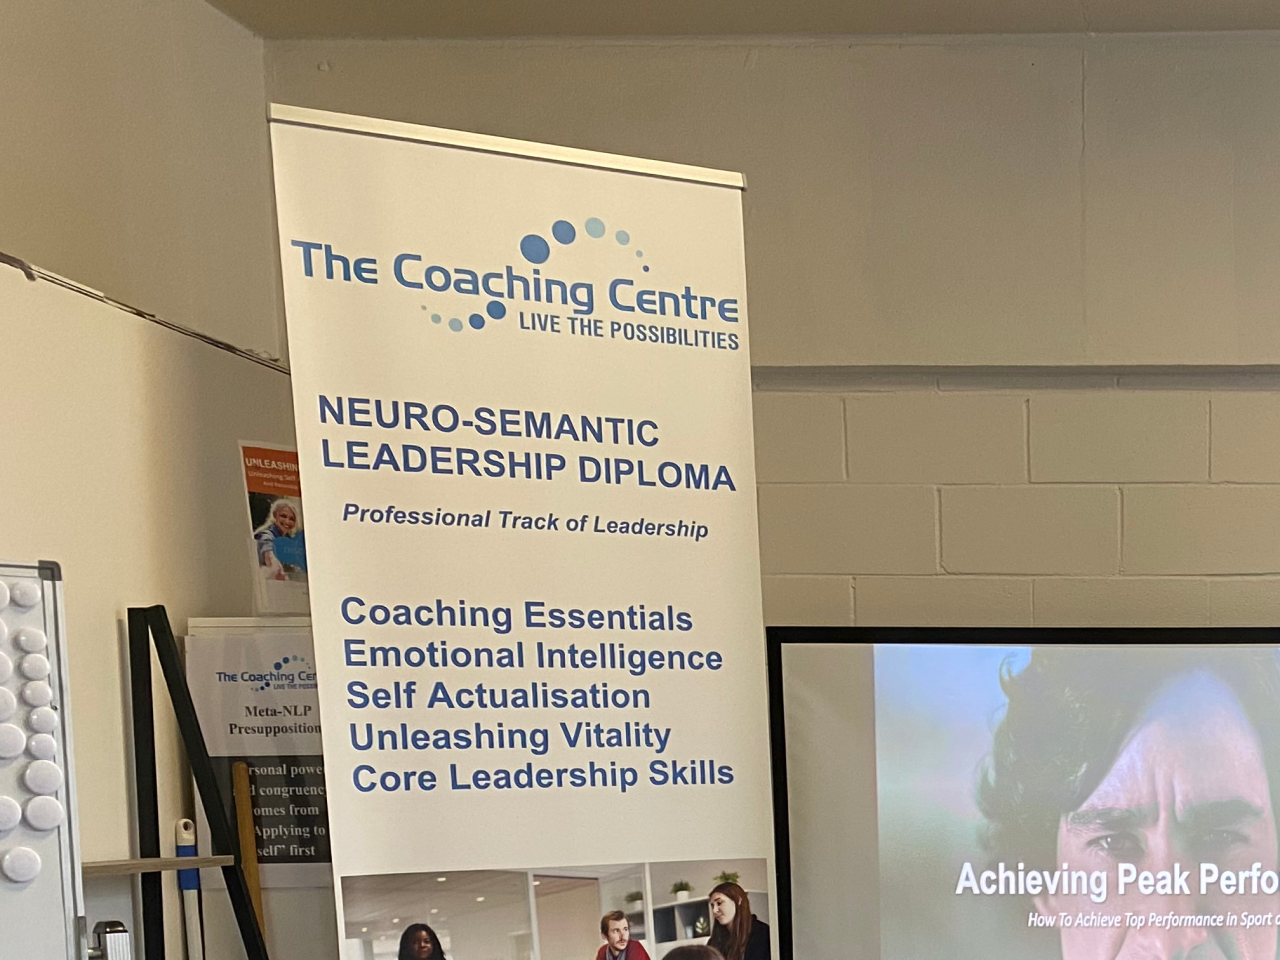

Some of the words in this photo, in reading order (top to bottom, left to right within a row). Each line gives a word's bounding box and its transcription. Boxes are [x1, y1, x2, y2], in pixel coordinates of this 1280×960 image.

[291, 239, 378, 284] The
[393, 253, 594, 316] Coaching
[609, 279, 739, 323] Centre
[519, 311, 561, 334] LIVE
[567, 317, 603, 338] THE
[610, 321, 739, 351] POSSIBILITIES
[319, 394, 659, 447] NEURO-SEMANTIC
[321, 439, 566, 481] LEADERSHIP
[579, 455, 737, 492] DIPLOMA
[342, 503, 490, 528] Professional
[498, 511, 560, 532] Track
[566, 513, 588, 533] of
[593, 515, 709, 542] Leadership
[340, 596, 512, 634] Coaching
[524, 601, 693, 632] Essentials
[343, 638, 524, 668] Emotional
[536, 641, 723, 676] Intelligence
[215, 672, 238, 682] The
[240, 671, 295, 684] Coaching
[346, 680, 416, 709] Self
[427, 681, 650, 709] Actualisation
[245, 705, 312, 718] Meta-NLP
[229, 723, 321, 737] Presupposition
[349, 722, 549, 755] Unleashing
[559, 721, 671, 753] Vitality
[248, 764, 286, 775] rsonal
[352, 764, 437, 793] Core
[449, 761, 638, 793] Leadership
[648, 759, 735, 787] Skills
[260, 786, 327, 798] congruenc
[253, 807, 286, 816] omes
[289, 804, 320, 816] from
[313, 826, 326, 835] to
[289, 844, 316, 856] first
[955, 862, 1108, 904] Achieving
[1117, 862, 1191, 895] Peak
[1028, 912, 1057, 927] How
[1059, 912, 1072, 927] To
[1075, 912, 1121, 927] Achieve
[1124, 912, 1146, 929] Top
[1148, 911, 1223, 929] Performance
[1226, 912, 1238, 926] in
[1240, 911, 1272, 929] Sport
